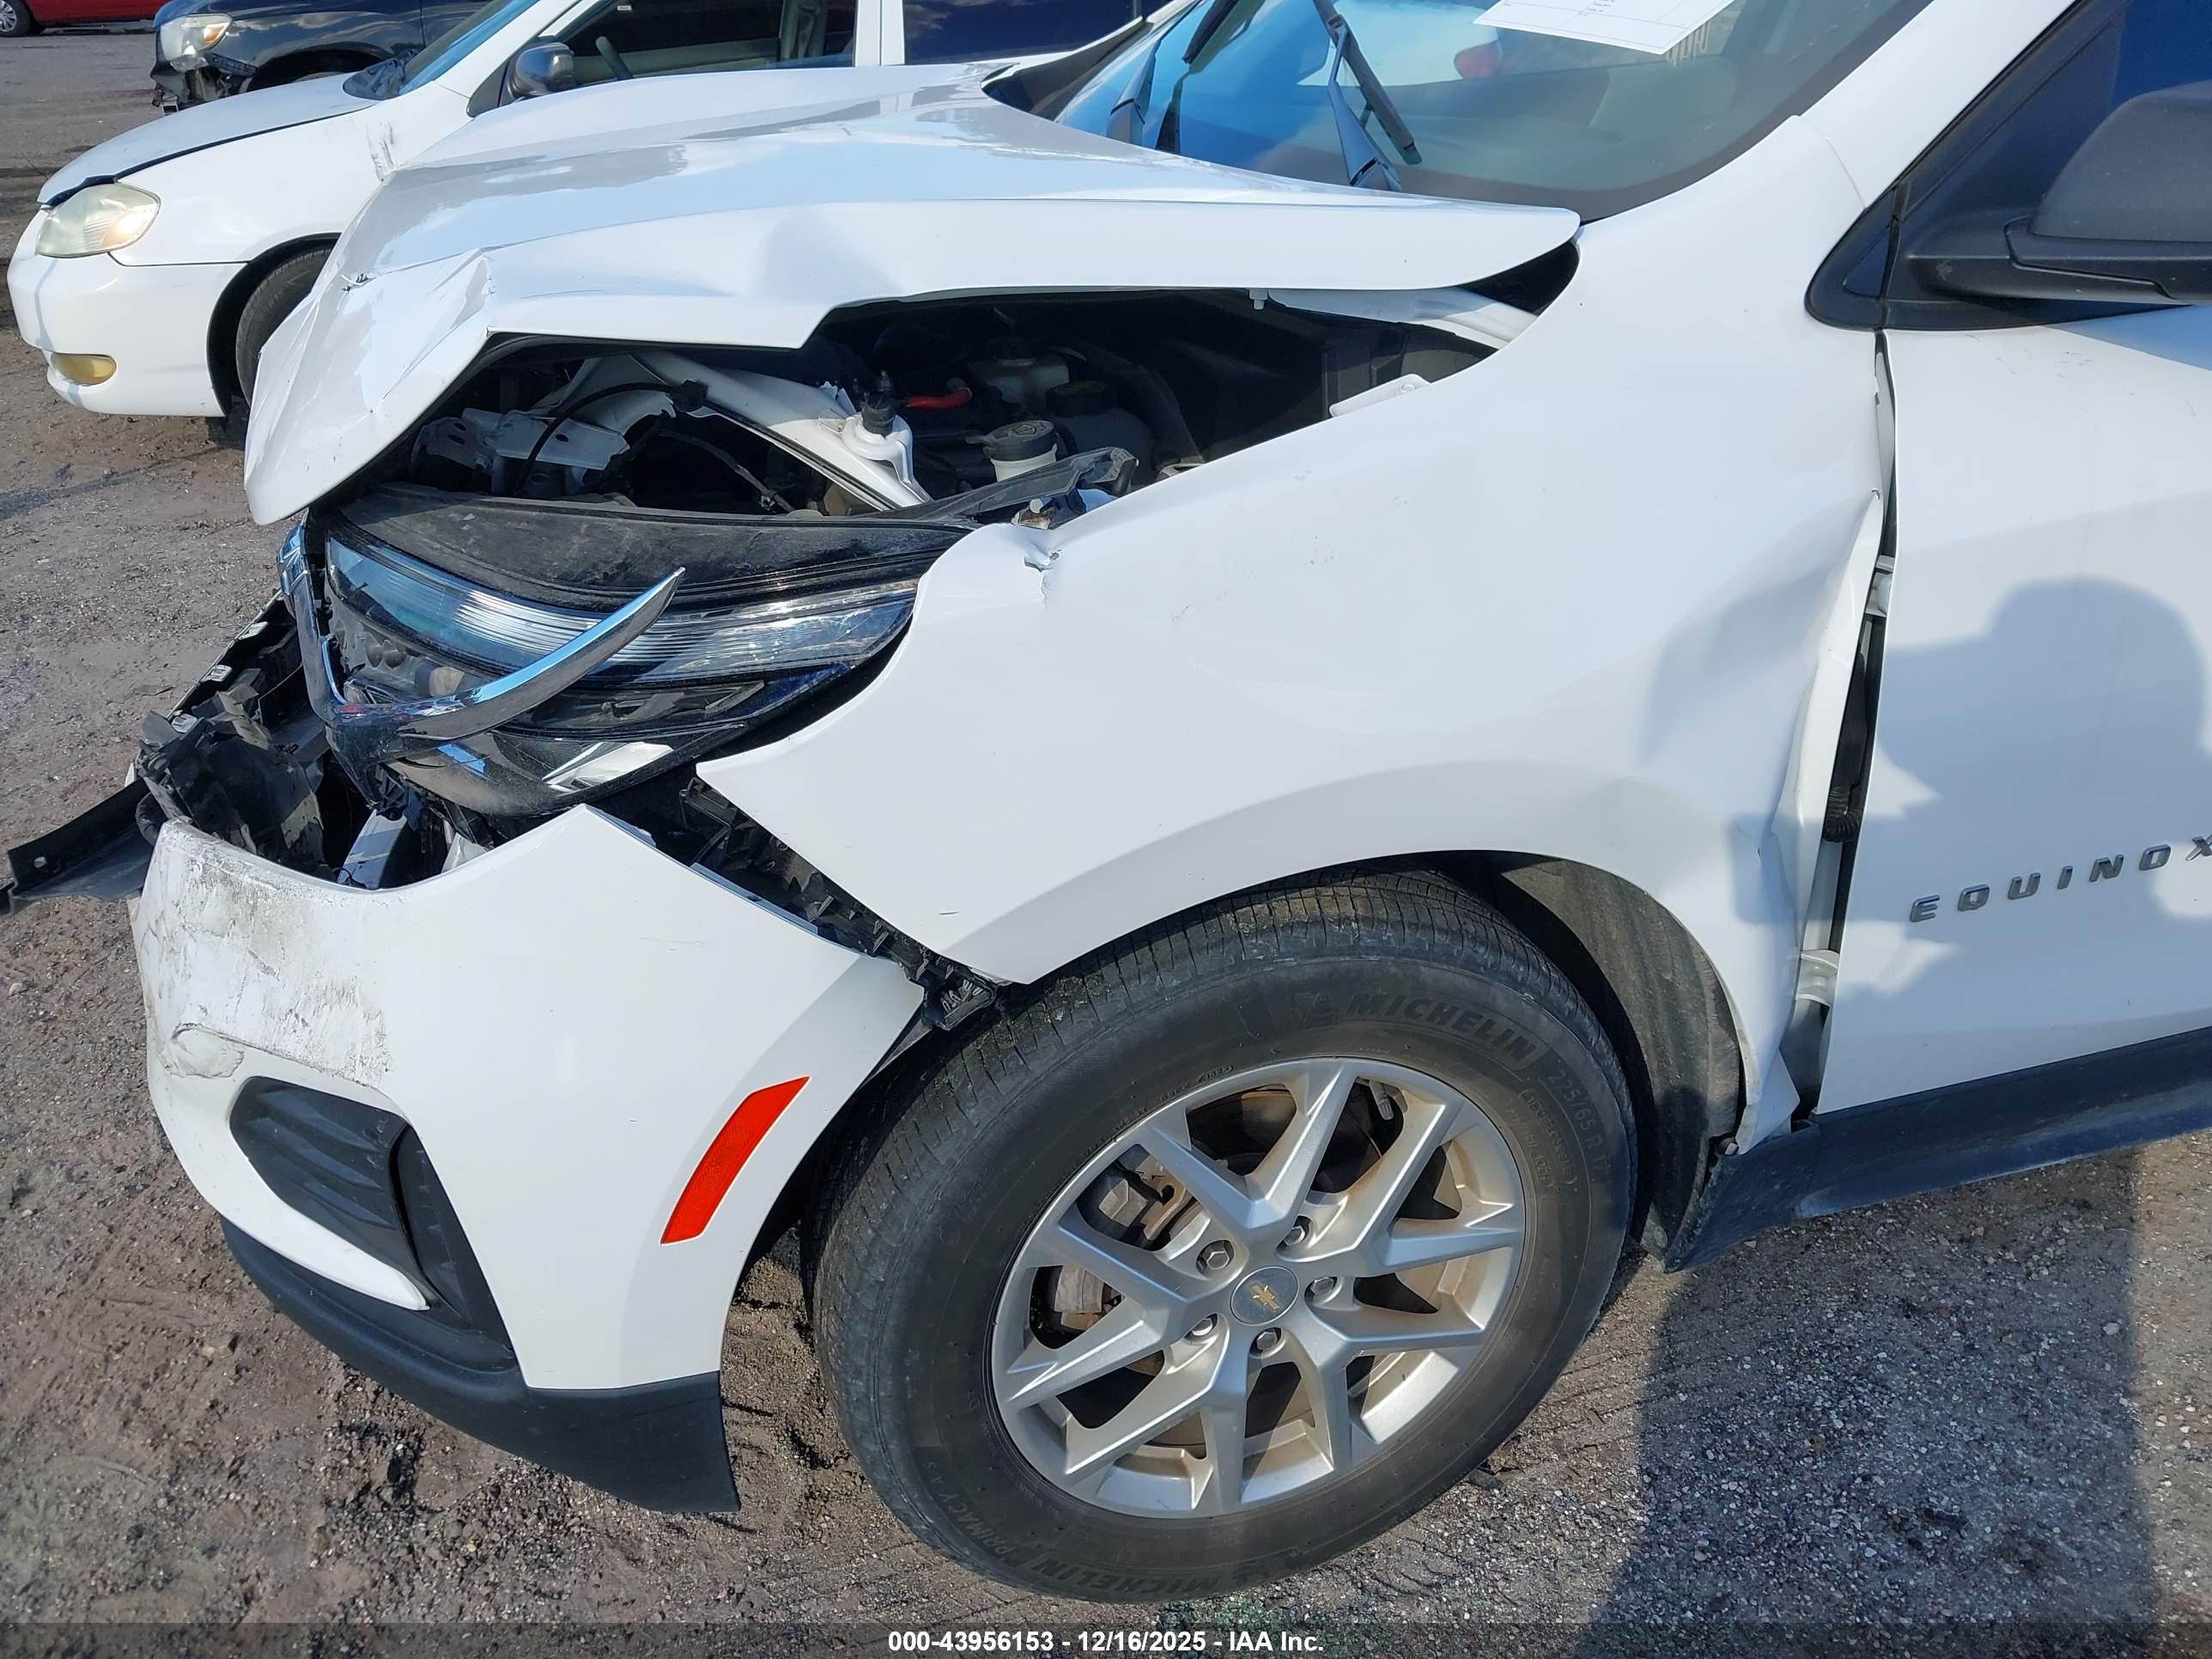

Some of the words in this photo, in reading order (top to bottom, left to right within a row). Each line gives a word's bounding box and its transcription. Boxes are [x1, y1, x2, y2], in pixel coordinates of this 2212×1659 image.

[1909, 834, 2212, 923] EQUINOX
[1345, 993, 1537, 1060] MICHELIN
[1547, 1071, 1597, 1131] 225/65
[1588, 1134, 1603, 1148] R
[939, 1492, 1017, 1556] PRIMACY
[1030, 1557, 1220, 1594] MICHELIN
